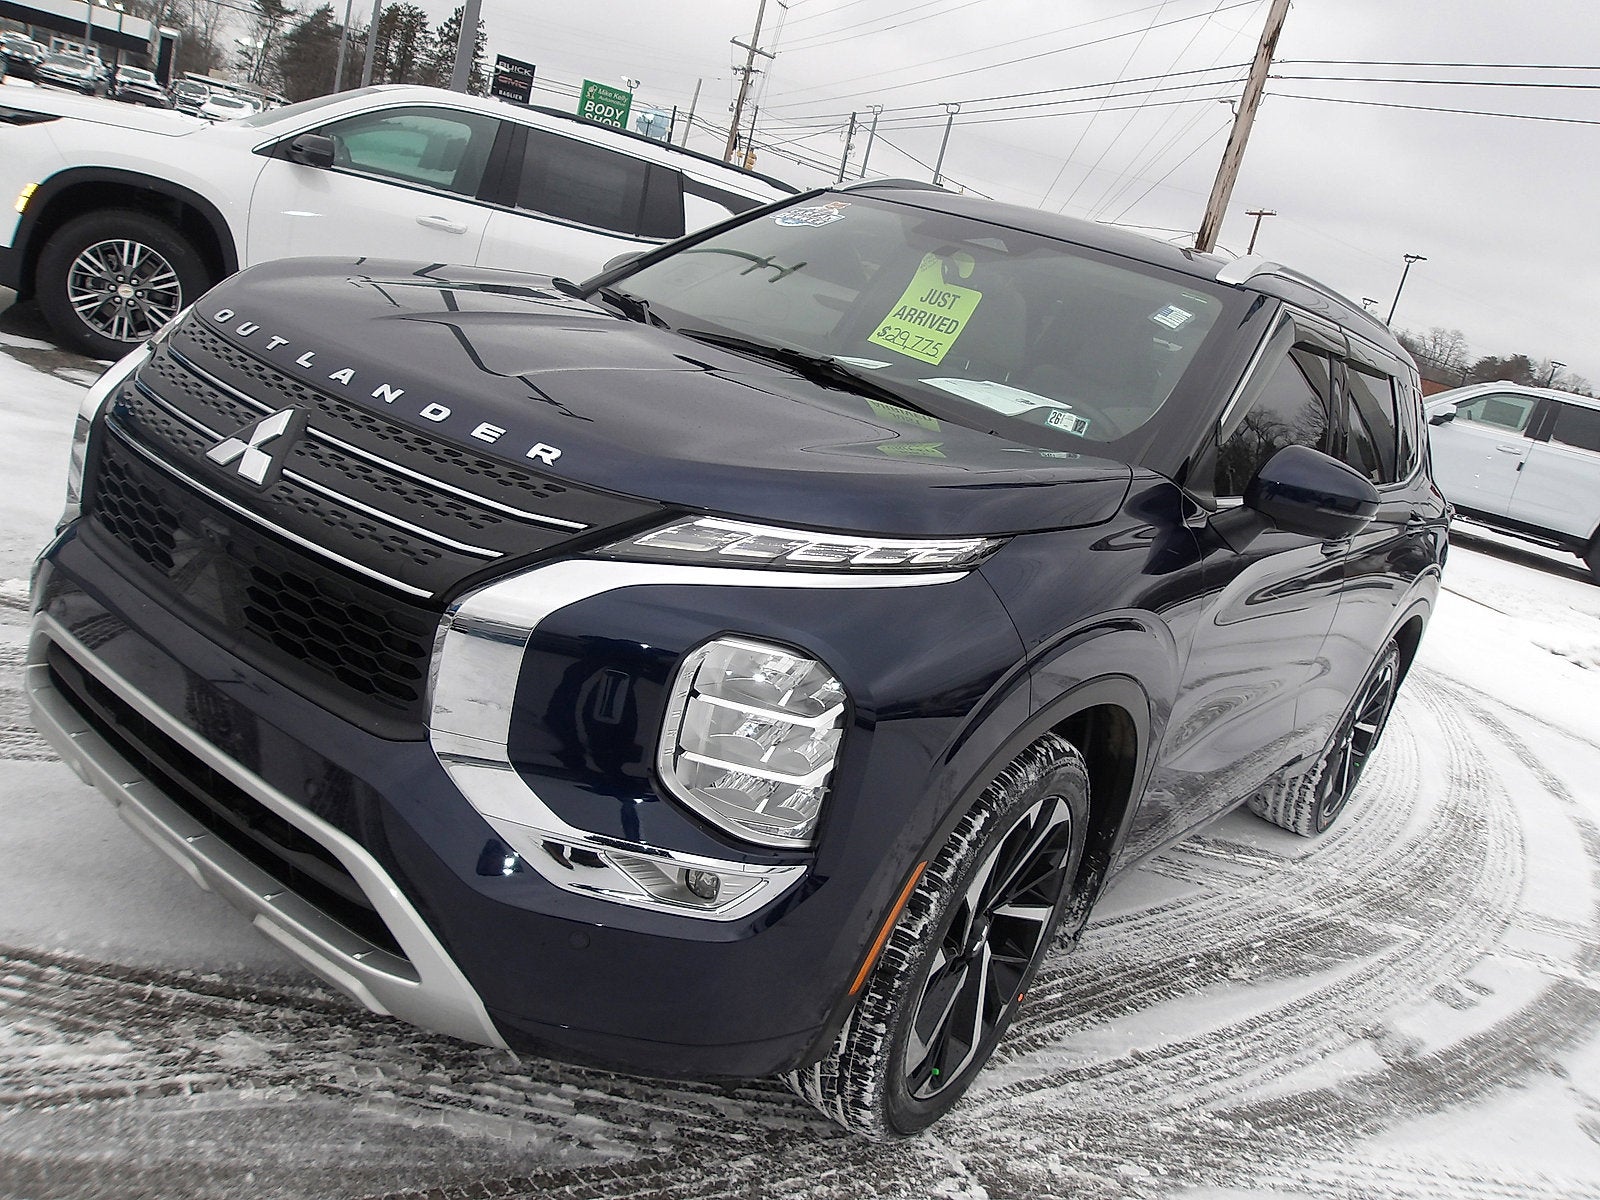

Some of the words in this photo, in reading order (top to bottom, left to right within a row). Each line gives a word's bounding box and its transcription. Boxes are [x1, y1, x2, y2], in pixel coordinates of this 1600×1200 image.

[499, 61, 532, 76] BUICK
[498, 75, 528, 90] GMC
[598, 88, 612, 97] Mike
[613, 92, 628, 103] Kelly
[584, 100, 624, 121] BODY
[920, 288, 961, 310] JUST
[892, 305, 959, 335] ARRIVED
[877, 325, 943, 357] $29,775
[214, 308, 563, 467] OUTLANDER
[1049, 411, 1062, 425] 26
